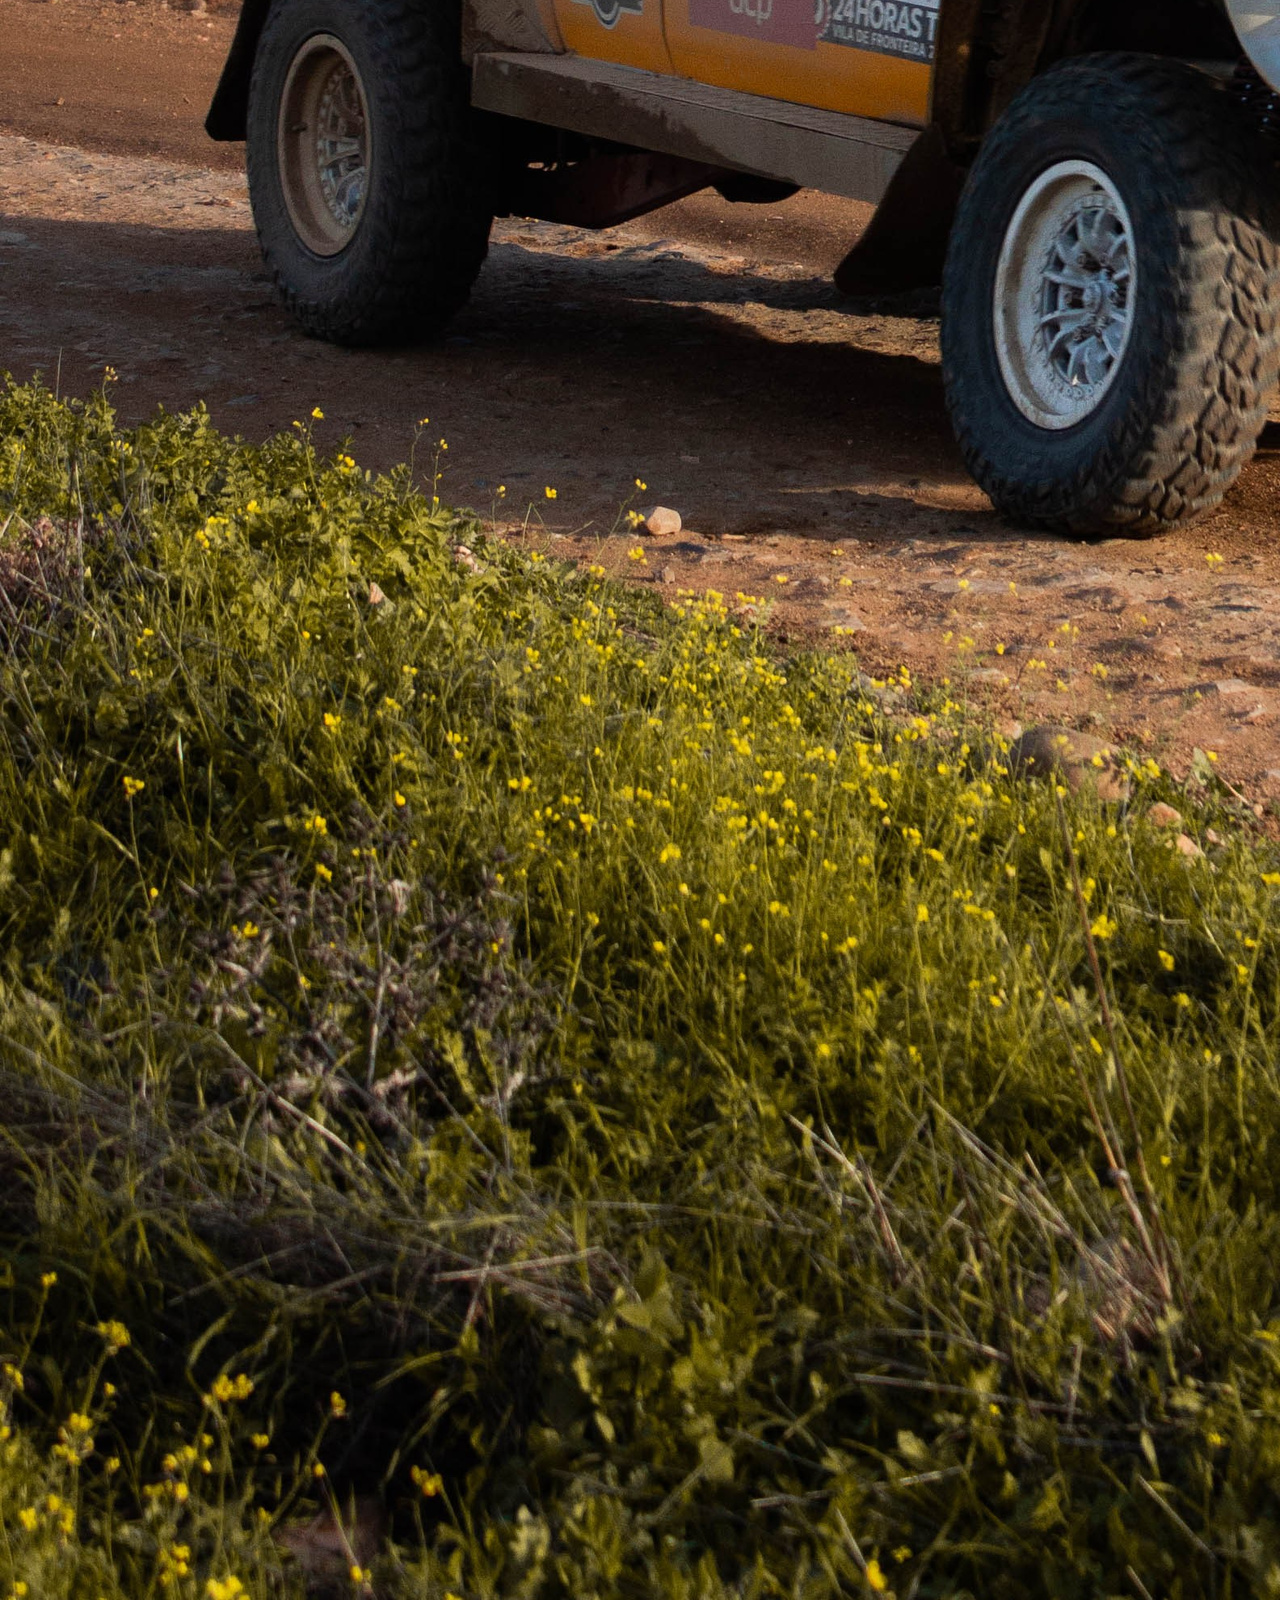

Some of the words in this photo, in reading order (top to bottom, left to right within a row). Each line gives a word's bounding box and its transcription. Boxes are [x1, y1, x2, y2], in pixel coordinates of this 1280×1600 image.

[832, 24, 855, 42] VILA
[855, 29, 869, 45] DE
[870, 32, 928, 59] FRONTEIRA
[926, 10, 939, 43] T
